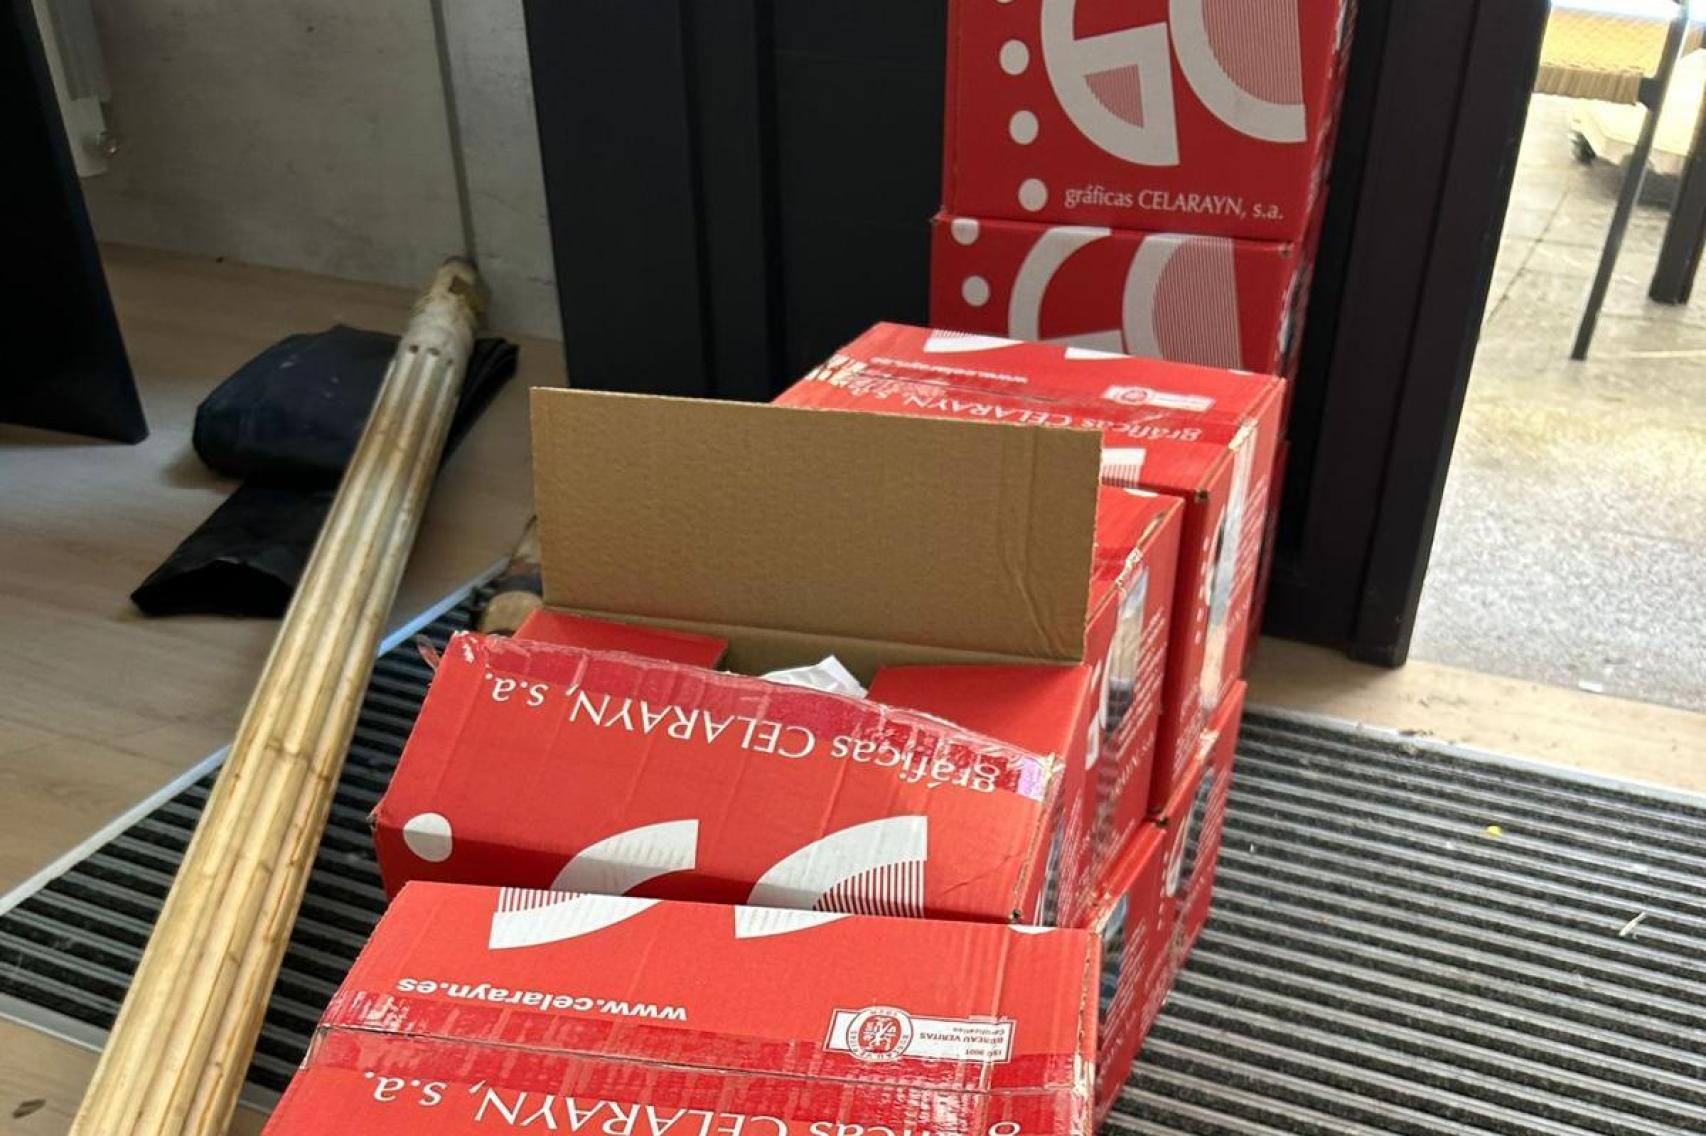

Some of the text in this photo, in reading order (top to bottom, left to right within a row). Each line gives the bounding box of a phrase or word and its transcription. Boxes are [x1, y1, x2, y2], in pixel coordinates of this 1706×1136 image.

[1065, 185, 1284, 219] gráficas CELARAYN, s.a.
[485, 672, 1001, 793] gráficas CELARAYN, s.a.
[397, 977, 688, 1022] www.celarayn.es
[364, 1071, 448, 1106] s.a.
